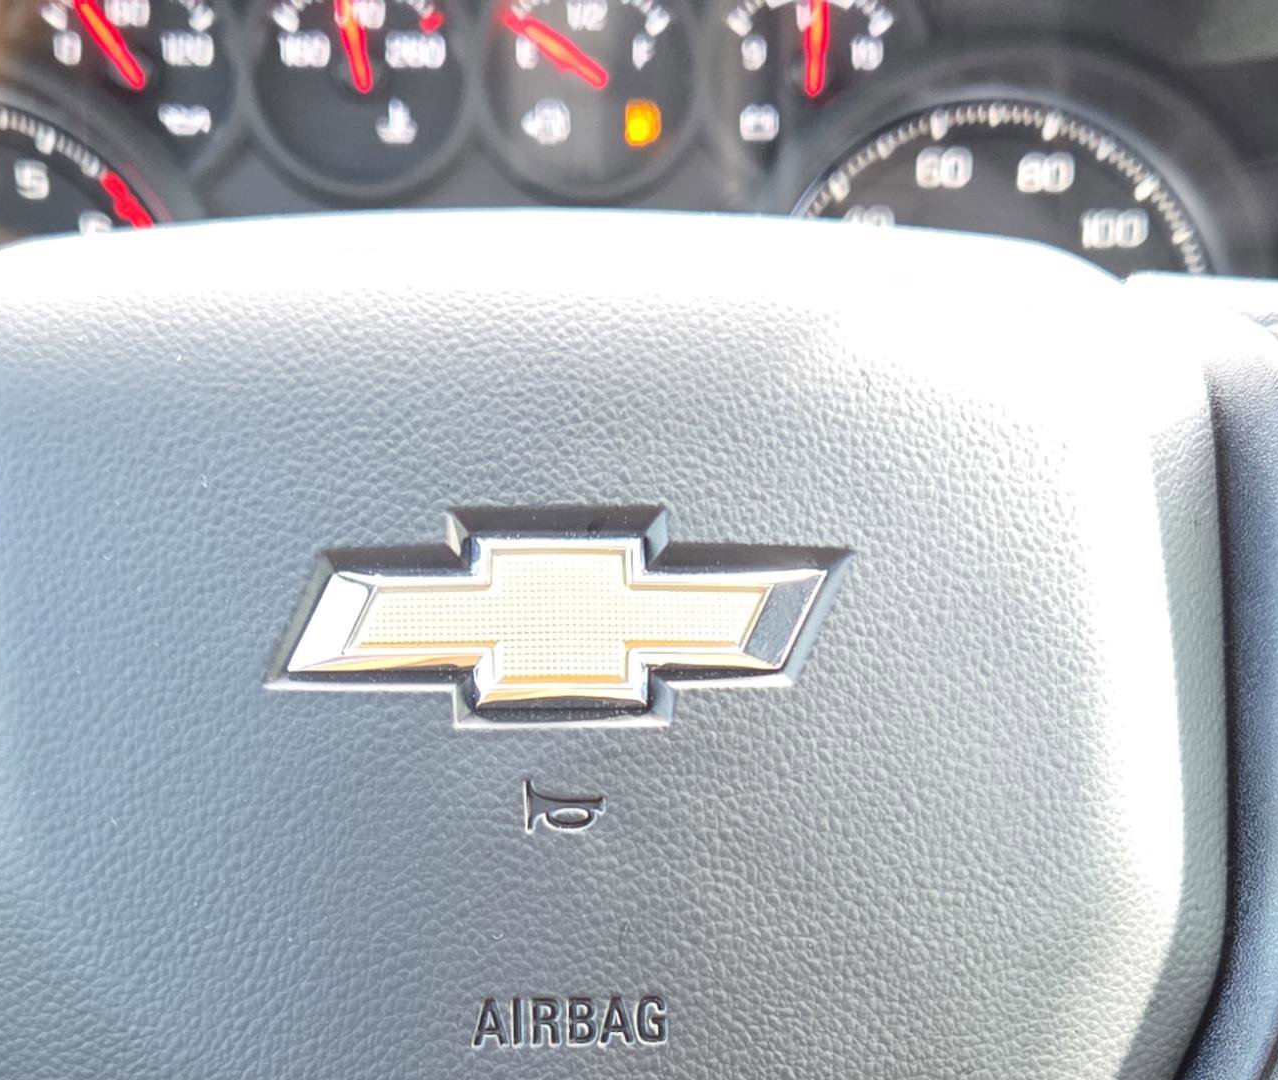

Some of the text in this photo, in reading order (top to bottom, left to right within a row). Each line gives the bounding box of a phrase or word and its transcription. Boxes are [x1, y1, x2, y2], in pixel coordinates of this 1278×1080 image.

[14, 159, 50, 200] 5
[916, 147, 973, 188] 60
[1017, 152, 1075, 193] 80
[1081, 208, 1149, 249] 100
[471, 995, 668, 1048] AIRBAG
